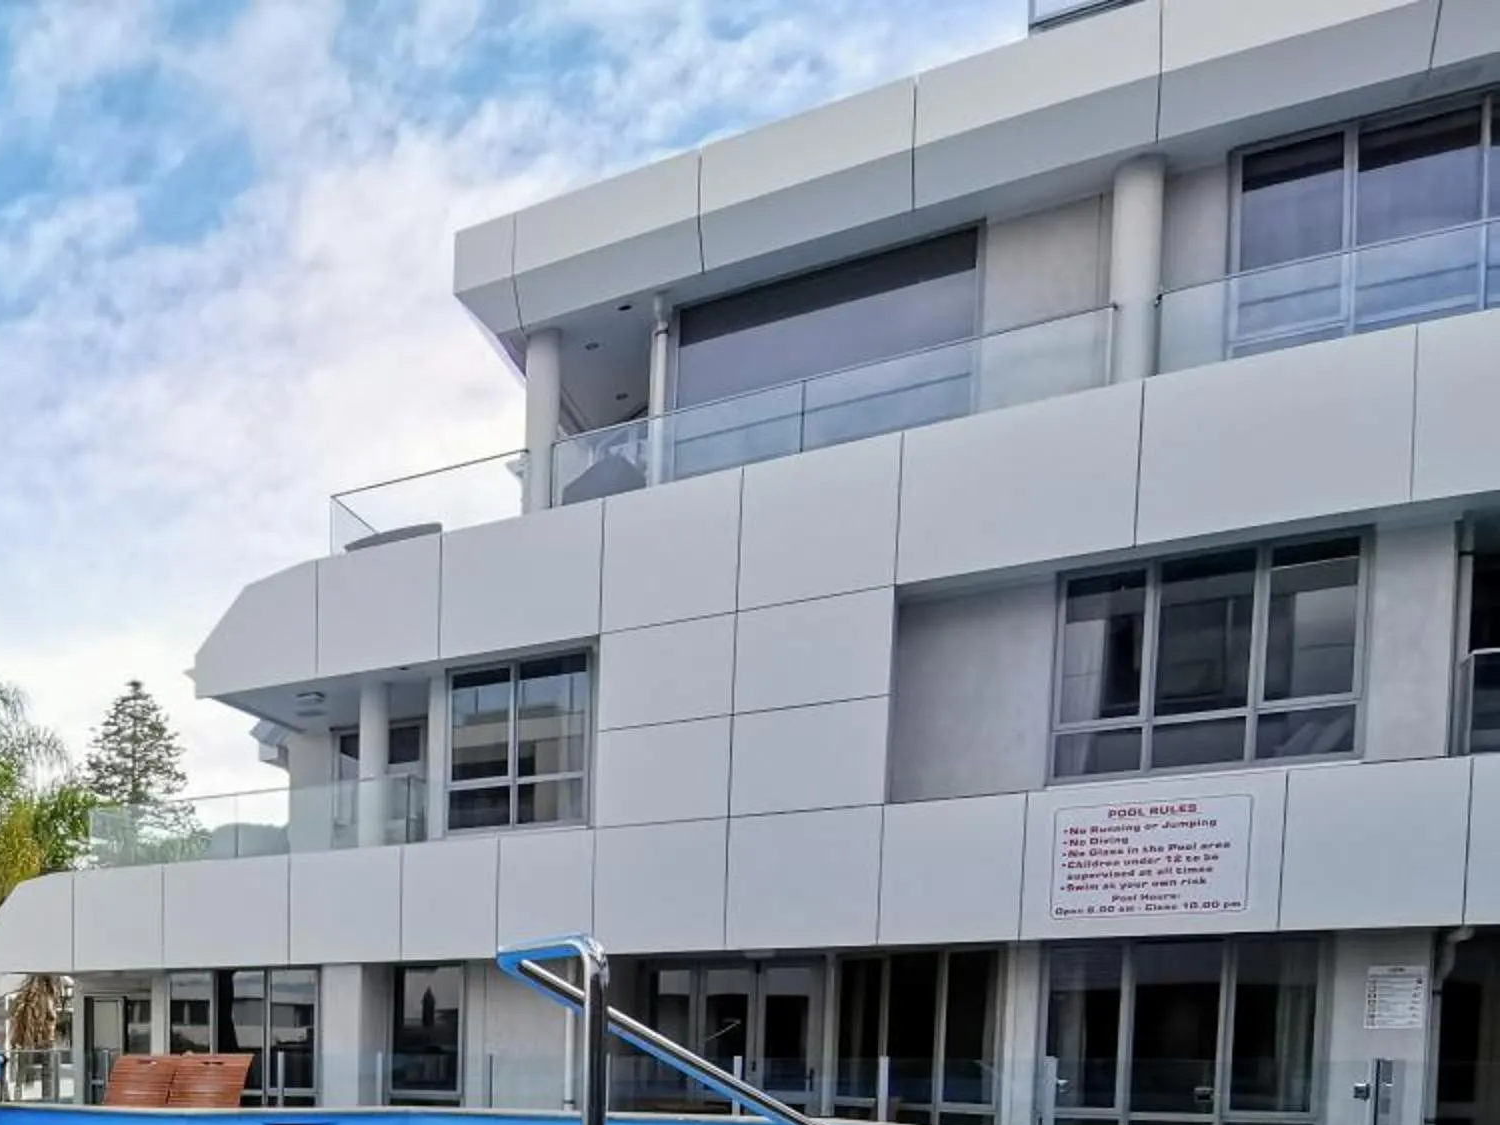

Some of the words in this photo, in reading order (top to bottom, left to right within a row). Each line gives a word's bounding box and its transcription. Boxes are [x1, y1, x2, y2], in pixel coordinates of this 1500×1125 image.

[1108, 807, 1145, 819] POOL
[1149, 803, 1197, 816] RULES
[1090, 824, 1141, 835] Running
[1161, 818, 1217, 830] Jumping
[1090, 836, 1129, 847] Diving
[1128, 845, 1139, 855] in
[1067, 858, 1121, 869] Children
[1123, 856, 1161, 867] under
[1067, 868, 1135, 882] supervised
